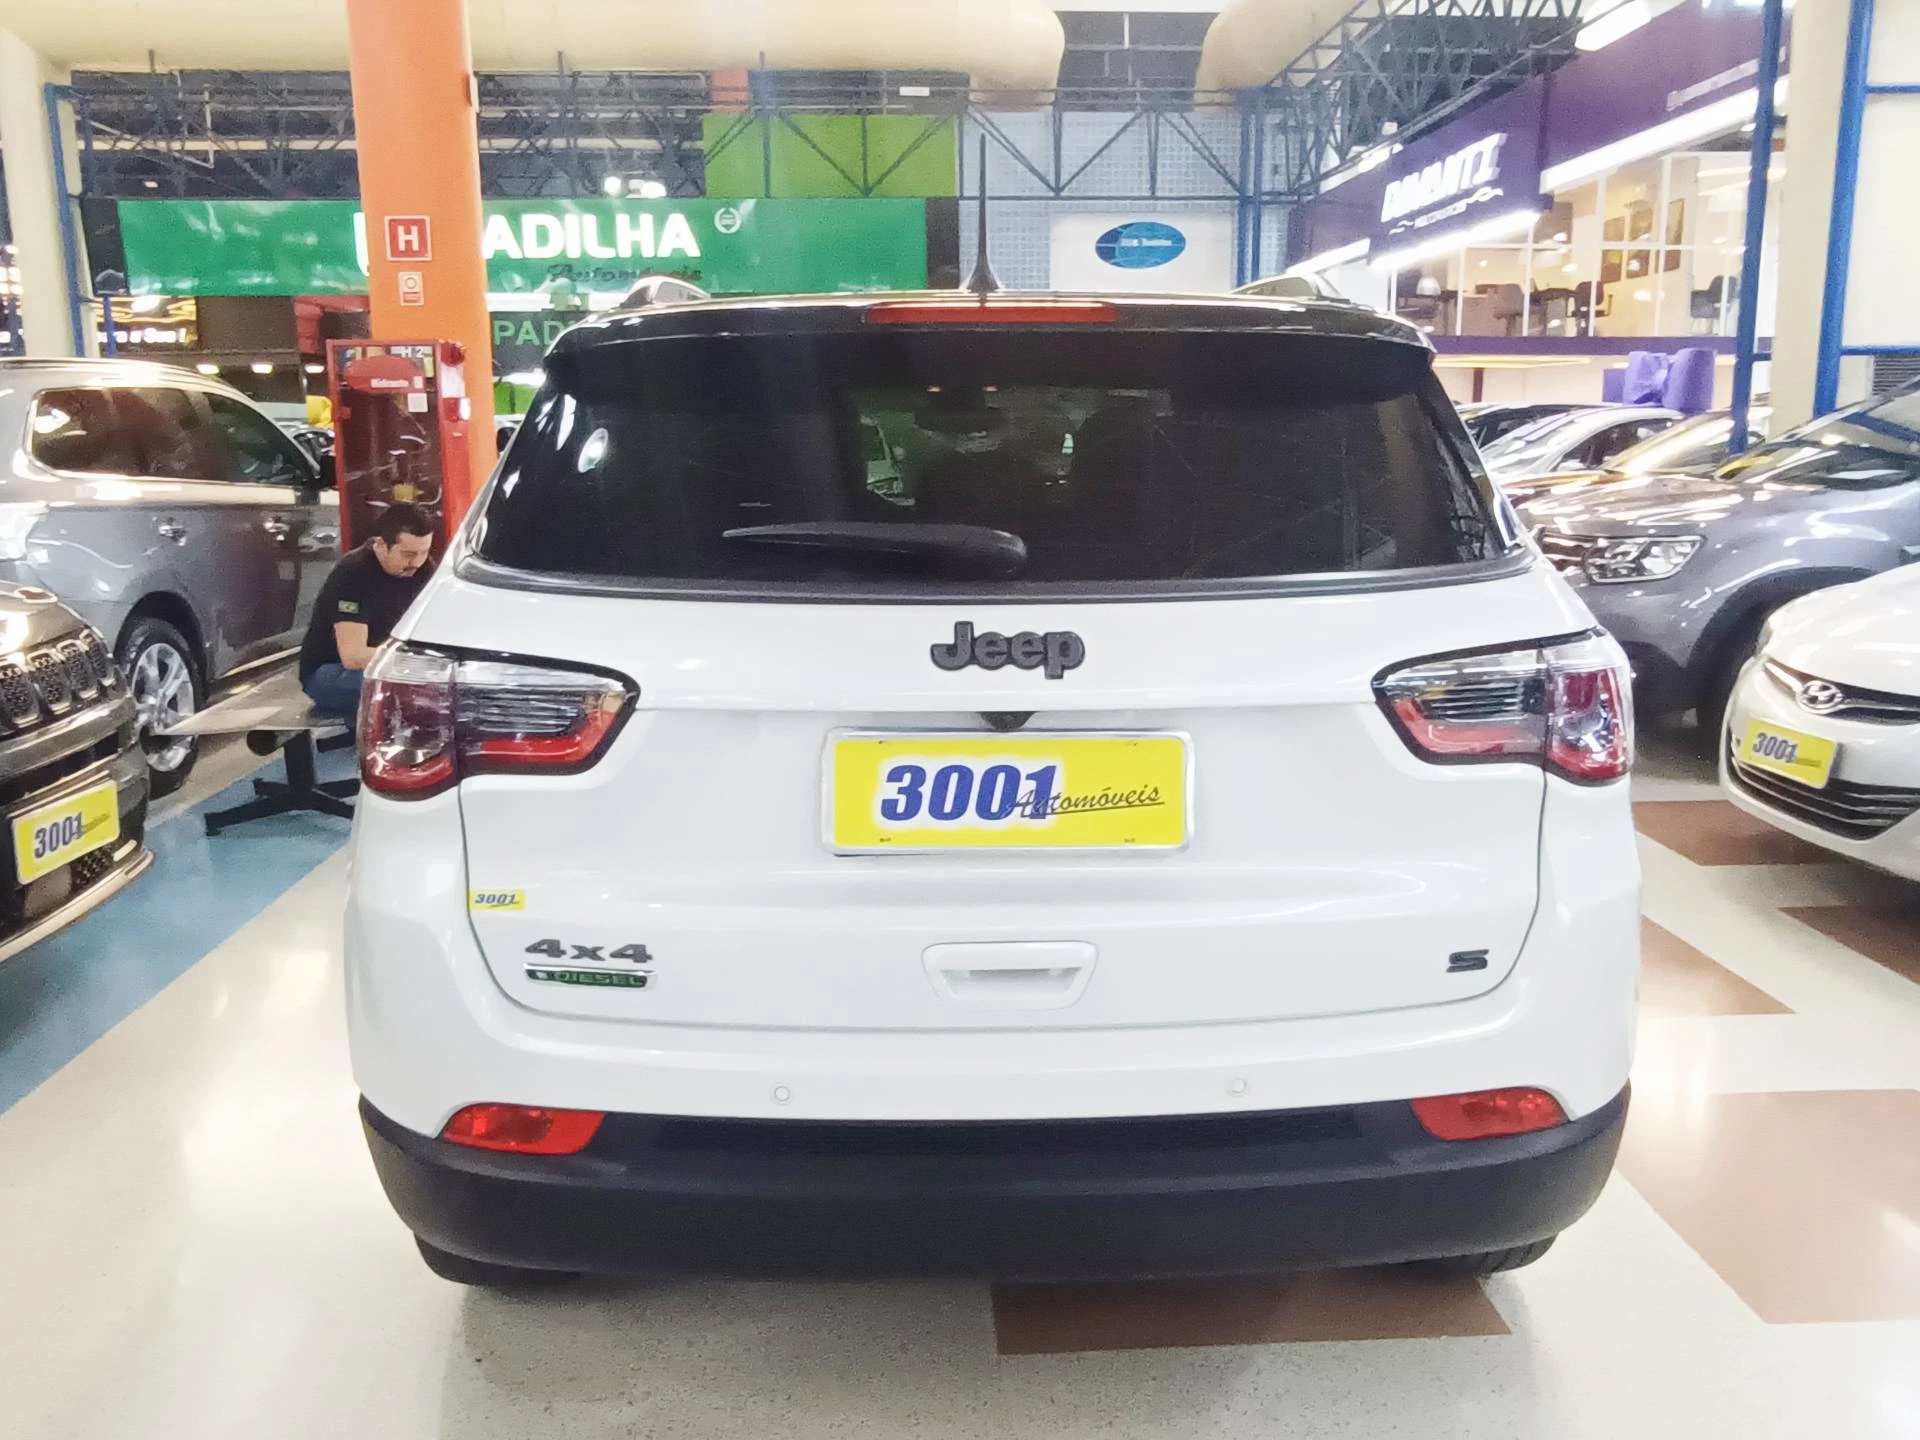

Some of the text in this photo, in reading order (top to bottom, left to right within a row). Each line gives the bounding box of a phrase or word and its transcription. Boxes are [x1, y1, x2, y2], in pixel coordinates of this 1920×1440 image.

[397, 224, 420, 252] H
[931, 620, 1086, 680] Jeep
[1752, 732, 1799, 764] 3001
[880, 763, 1058, 822] 3001
[1008, 784, 1162, 819] Automóveis
[34, 810, 83, 859] 3001
[475, 892, 519, 906] 3001
[525, 938, 653, 964] 4x4
[1446, 948, 1490, 973] S
[553, 971, 644, 986] DIESEL
